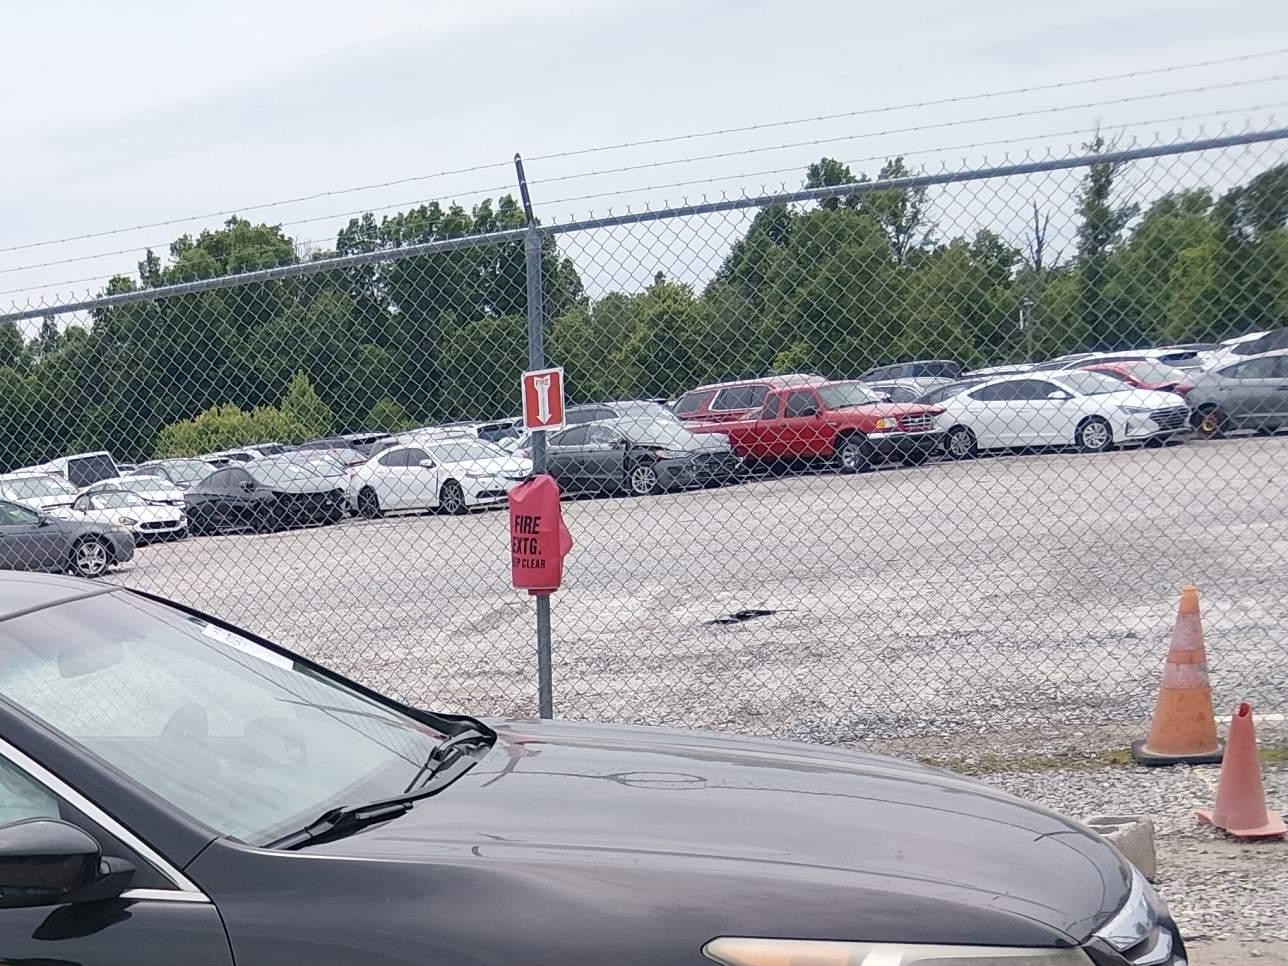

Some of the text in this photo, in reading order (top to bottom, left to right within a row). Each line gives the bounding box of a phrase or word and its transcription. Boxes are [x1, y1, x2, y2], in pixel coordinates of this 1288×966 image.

[514, 514, 542, 535] FIRE
[512, 536, 542, 556] EXTG.
[522, 558, 546, 569] CLEAR
